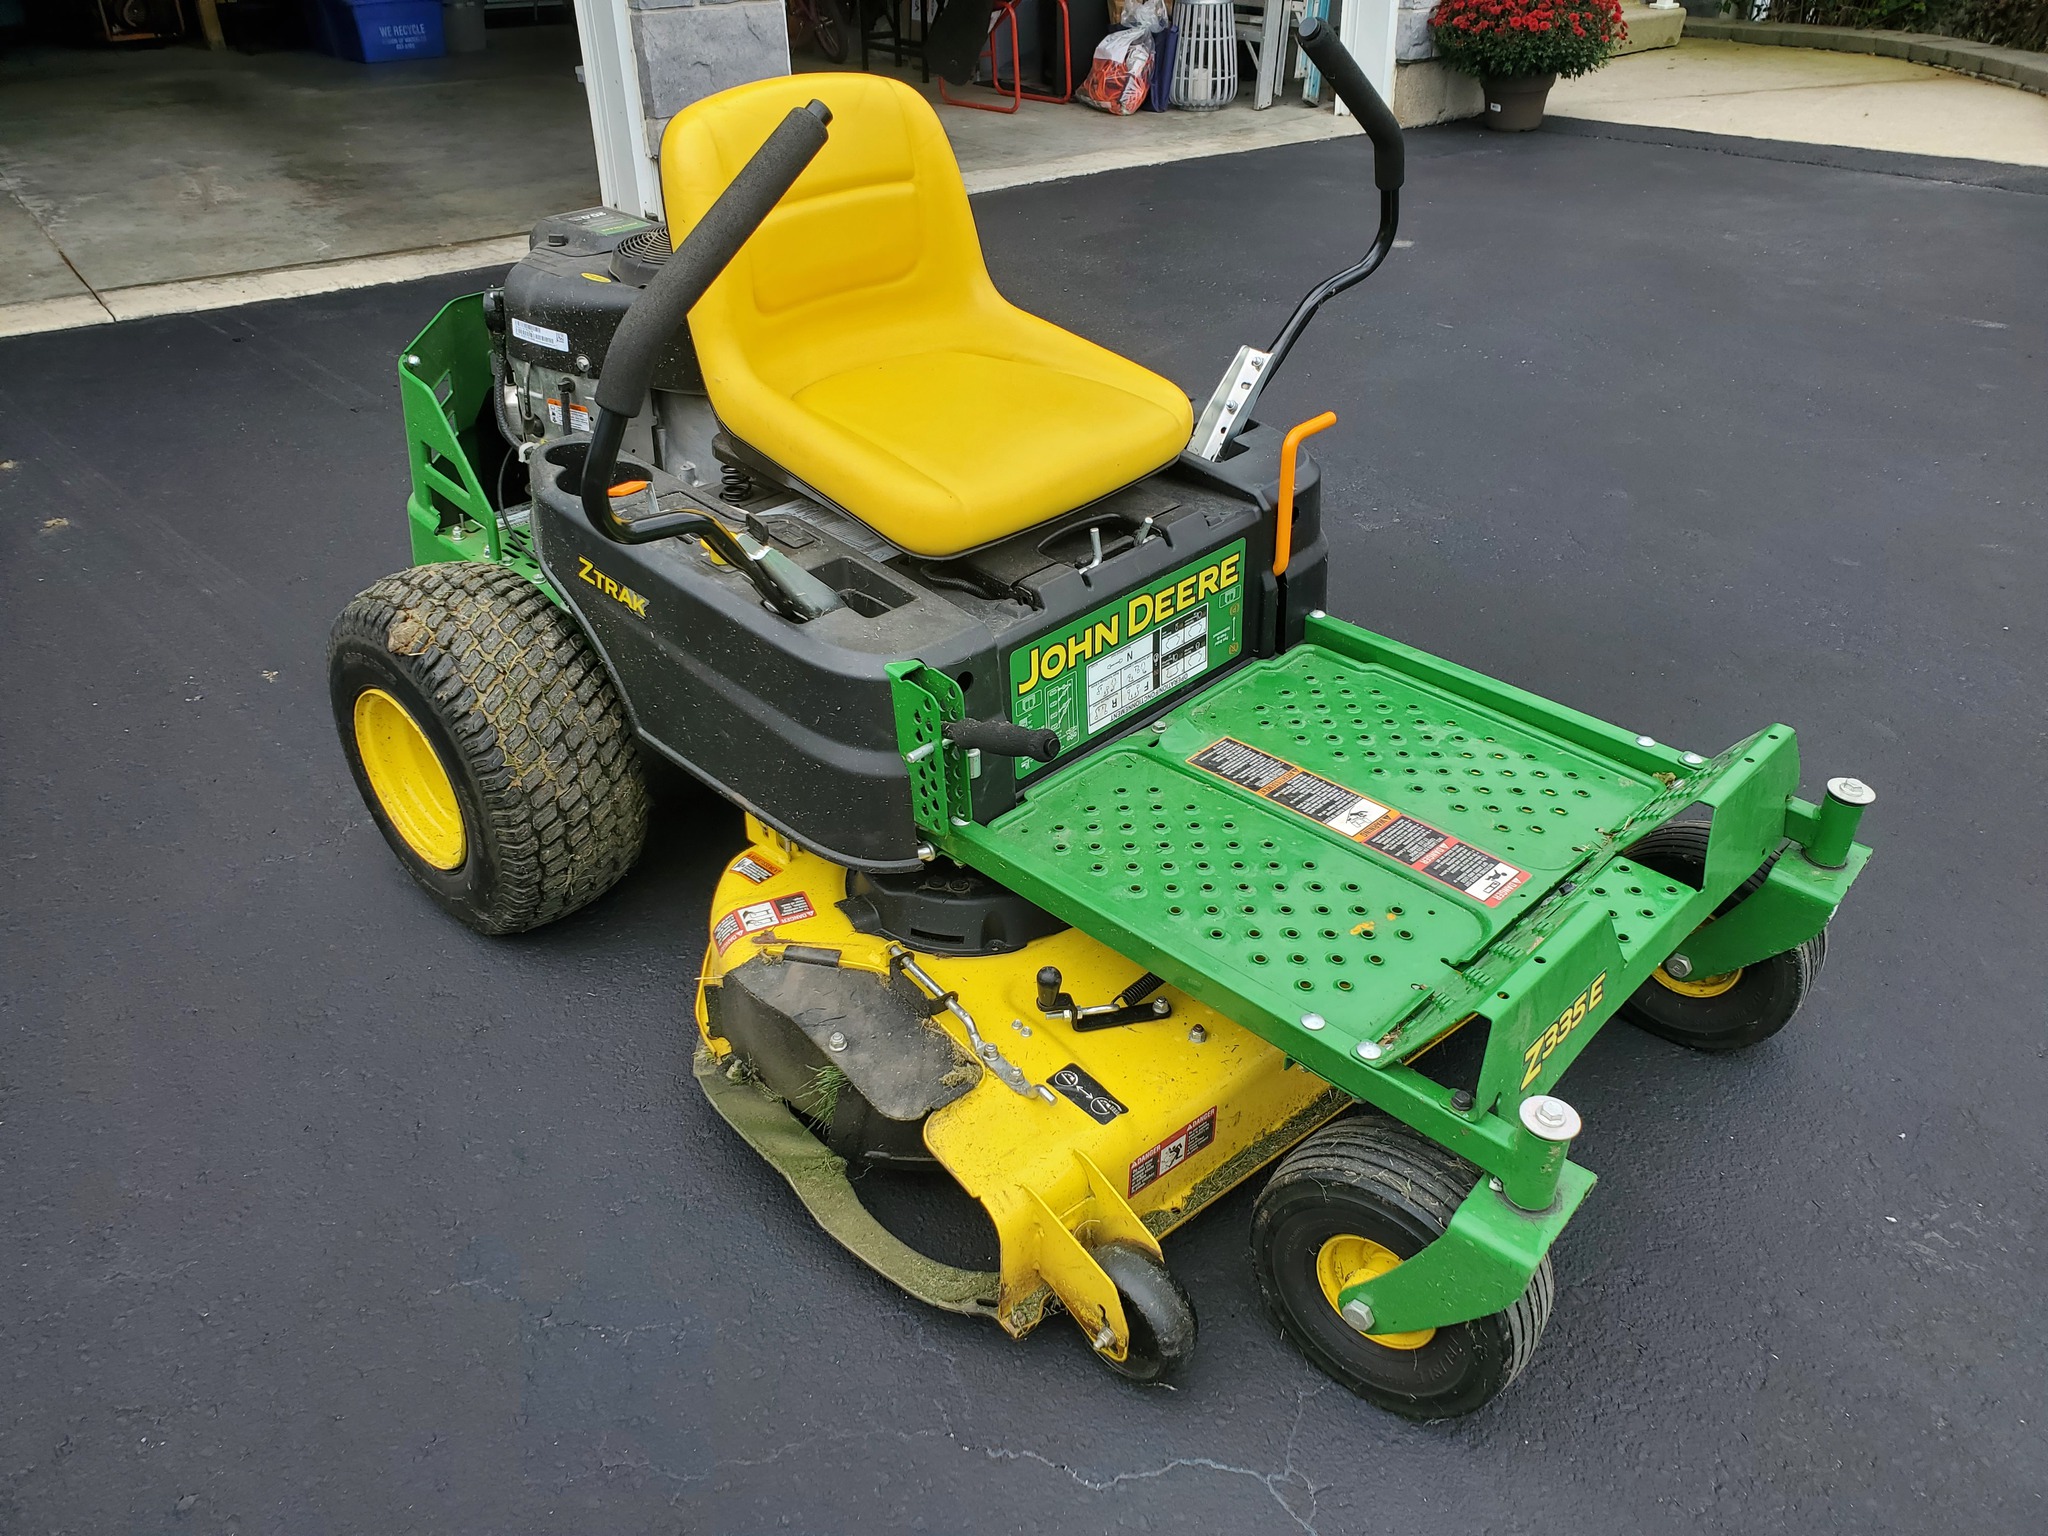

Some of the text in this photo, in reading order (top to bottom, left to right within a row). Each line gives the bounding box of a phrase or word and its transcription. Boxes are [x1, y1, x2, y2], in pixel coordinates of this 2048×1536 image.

[379, 24, 425, 37] WE RECYCLE
[578, 555, 647, 618] ZTRAK
[1018, 553, 1240, 695] JOHN DEERE
[1358, 818, 1387, 837] WARNING
[1418, 846, 1445, 864] DANGER
[1491, 881, 1519, 900] DANGER
[781, 911, 808, 923] DANGER
[1520, 972, 1606, 1092] Z335E
[1192, 1108, 1215, 1128] DANGER
[1137, 1144, 1161, 1164] DANGER
